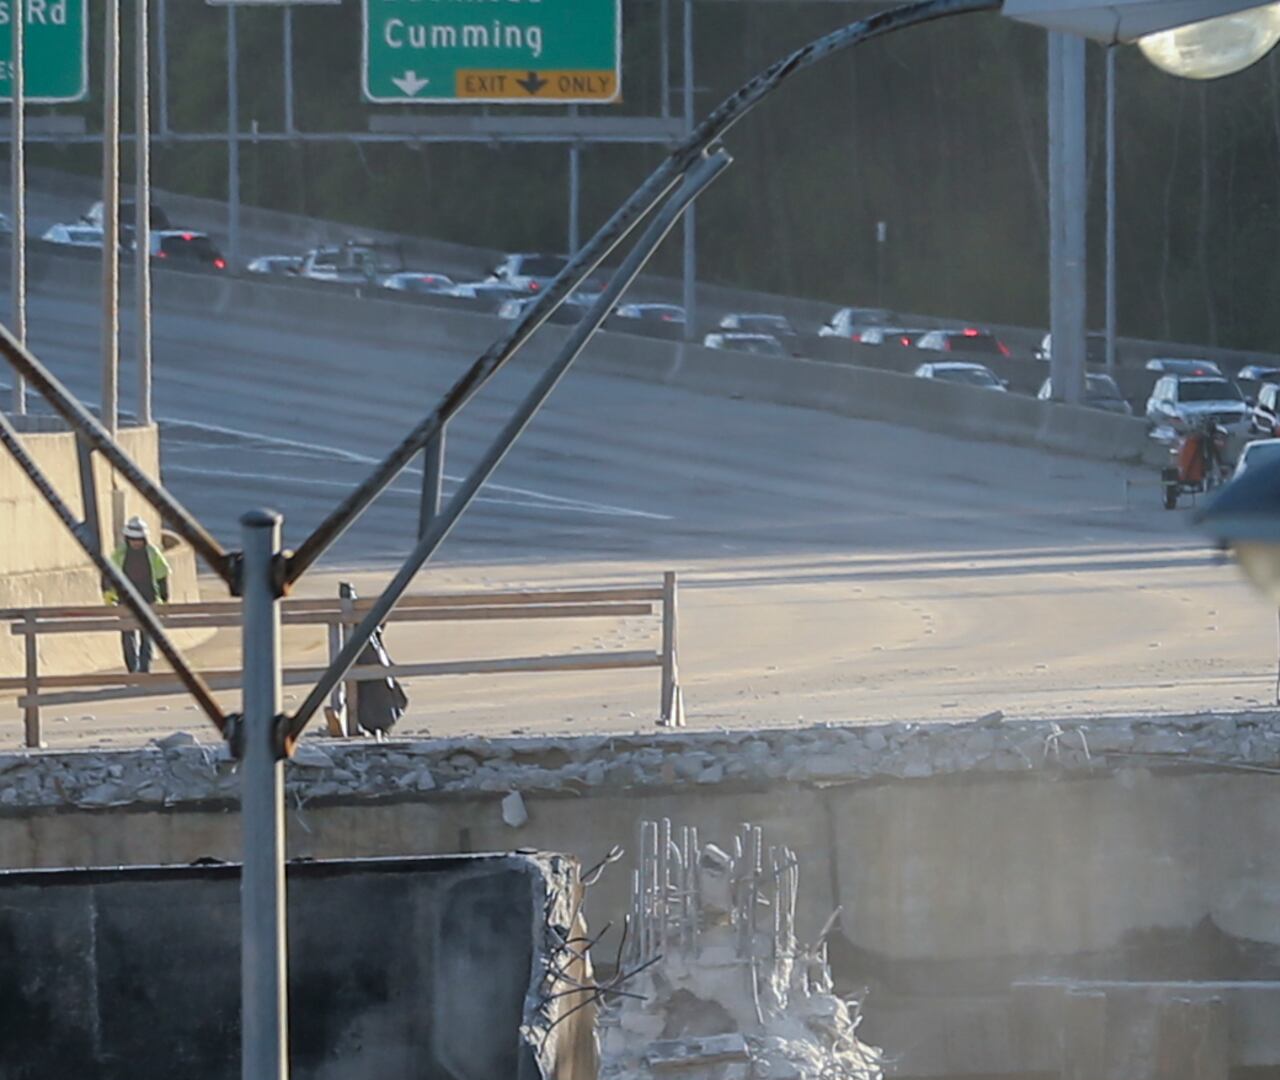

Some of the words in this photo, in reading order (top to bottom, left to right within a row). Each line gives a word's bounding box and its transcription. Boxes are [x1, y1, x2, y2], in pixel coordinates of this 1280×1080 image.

[28, 0, 66, 24] Rd
[384, 18, 542, 58] Cumming
[465, 76, 507, 93] EXIT
[557, 76, 611, 93] ONLY
